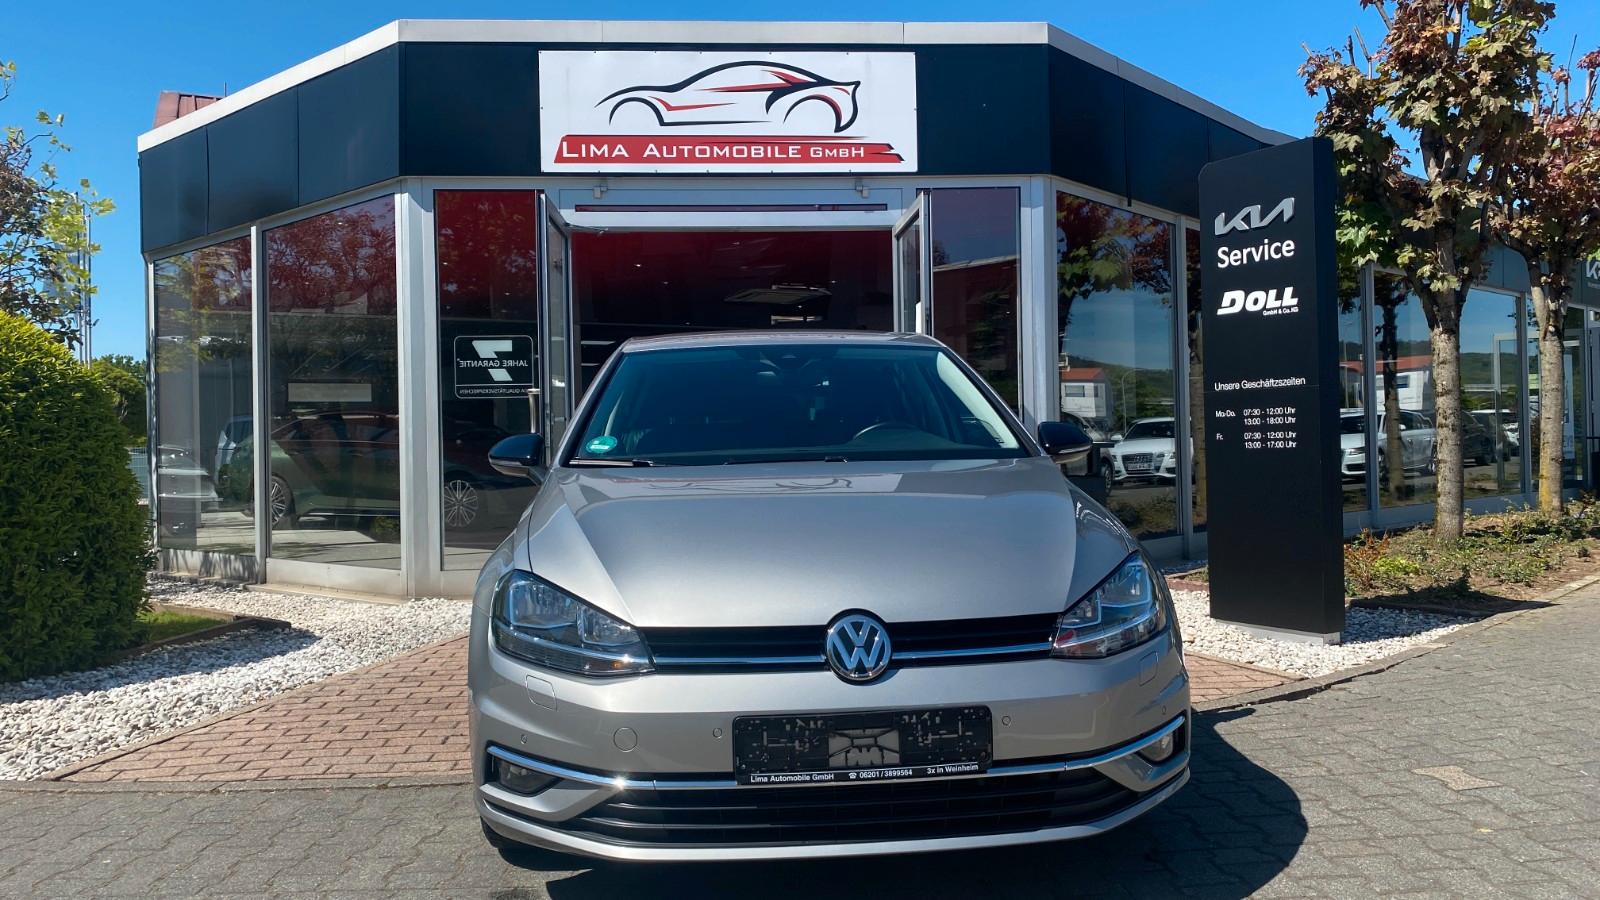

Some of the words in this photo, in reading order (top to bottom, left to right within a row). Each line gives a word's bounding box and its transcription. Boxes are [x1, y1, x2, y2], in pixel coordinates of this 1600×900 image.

[1214, 197, 1295, 236] KIA
[1217, 239, 1295, 268] Service
[1217, 286, 1298, 315] DOLL
[1214, 381, 1240, 392] Unsere
[1243, 408, 1261, 416] 07:30
[1266, 407, 1284, 415] 12:00
[1284, 406, 1296, 414] Uhr
[1284, 416, 1296, 424] Uhr
[1244, 432, 1261, 440] 07:30
[1267, 431, 1284, 439] 12:00
[1285, 430, 1297, 438] Uhr
[1245, 441, 1261, 449] 13:00
[1267, 440, 1285, 448] 17:00
[1285, 440, 1297, 448] Uhr
[750, 775, 768, 783] Lima
[769, 774, 811, 782] Automobile
[812, 773, 834, 781] GmbH
[927, 767, 936, 775] 3x
[936, 765, 944, 773] in
[944, 763, 979, 773] Weinheim
